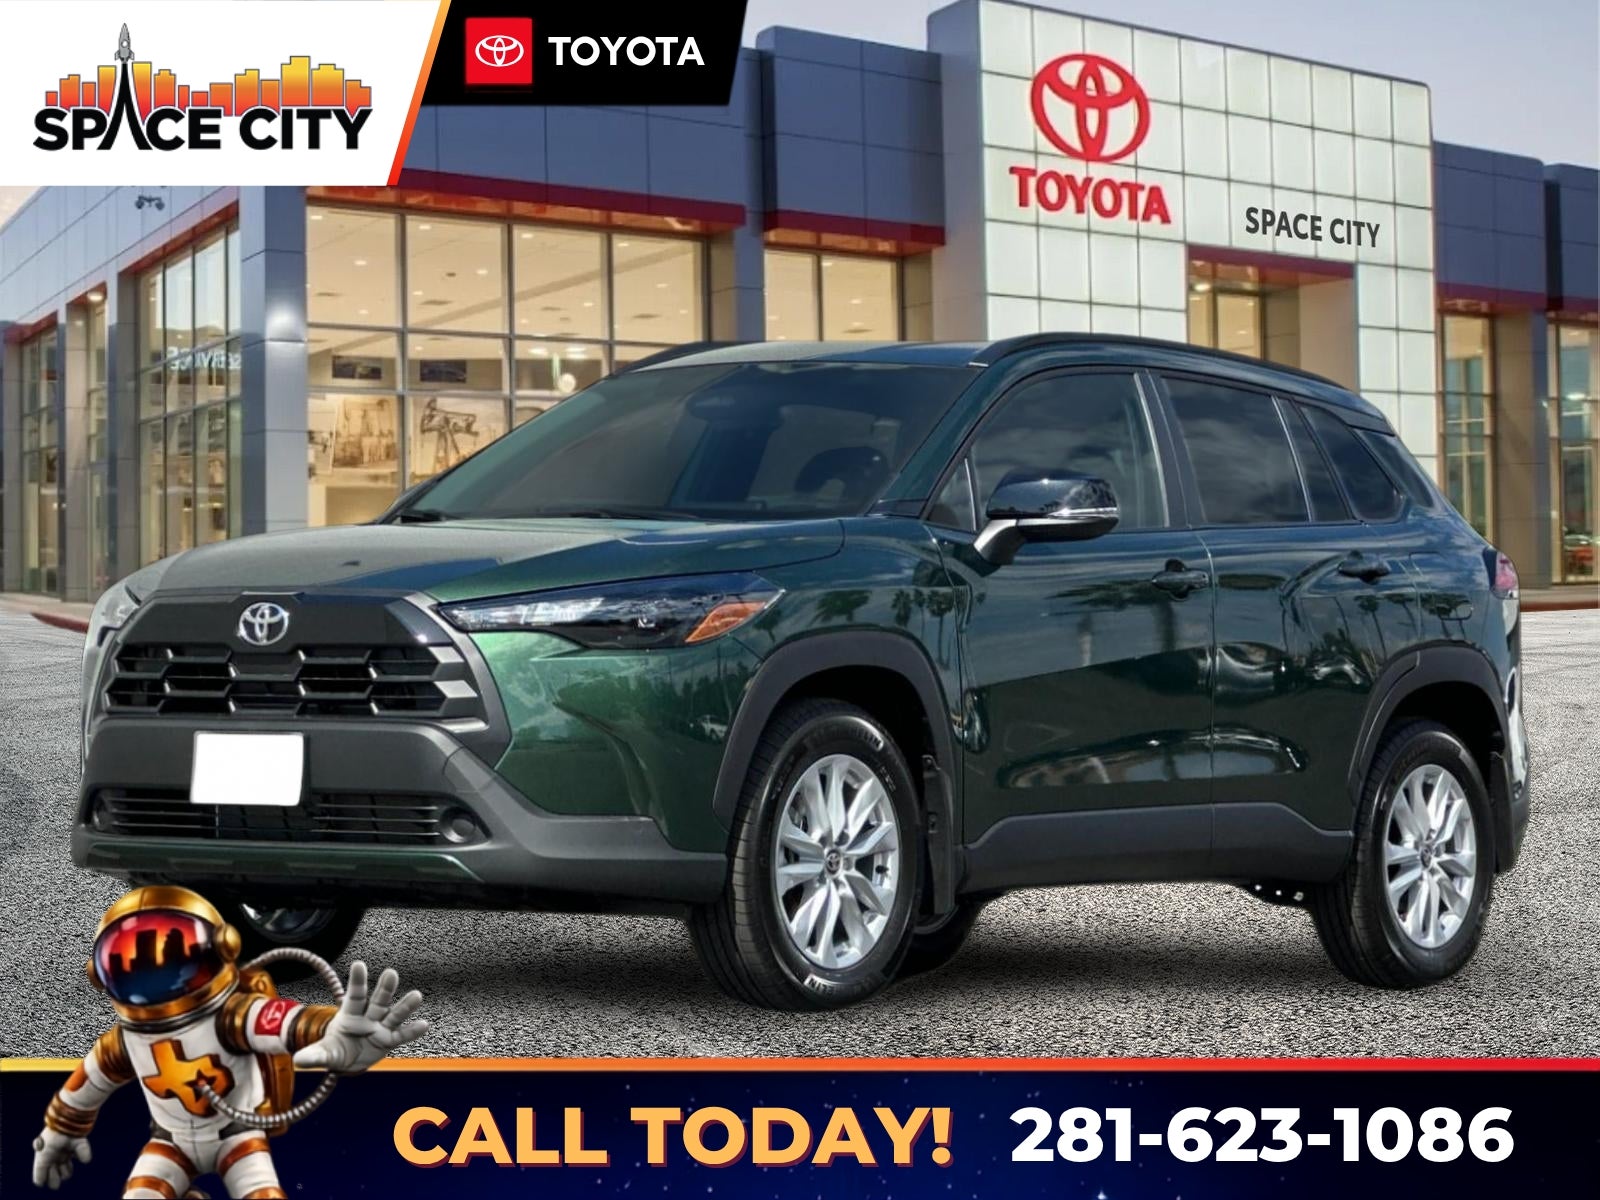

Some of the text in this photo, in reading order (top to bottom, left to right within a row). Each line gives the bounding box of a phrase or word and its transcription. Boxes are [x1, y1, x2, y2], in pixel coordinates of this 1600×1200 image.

[1009, 166, 1171, 224] TOYOTA
[1245, 206, 1381, 248] SPACE CITY
